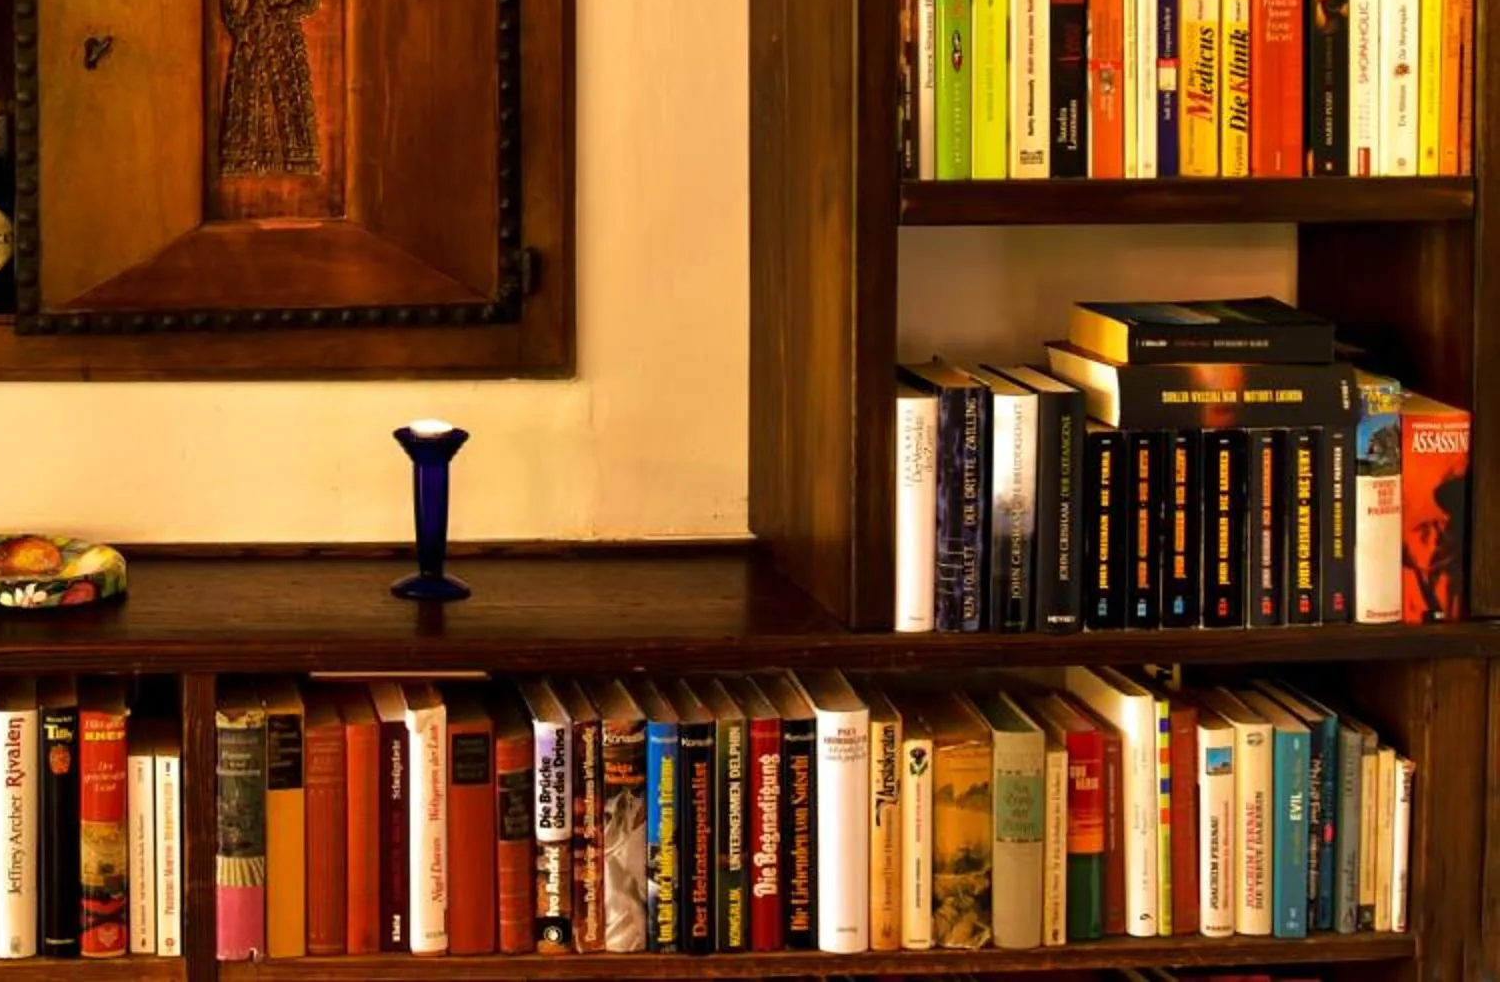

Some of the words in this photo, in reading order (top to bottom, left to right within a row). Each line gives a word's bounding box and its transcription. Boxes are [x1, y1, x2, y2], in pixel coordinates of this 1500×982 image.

[1228, 29, 1248, 94] Klinik
[1357, 1, 1370, 85] SHOPAHOLIC
[1186, 26, 1215, 124] Medicus
[1057, 107, 1068, 144] Sandra
[1228, 95, 1248, 133] Die
[963, 397, 976, 451] ZWILLING
[963, 456, 976, 499] DRITTE
[1297, 449, 1312, 478] JURY
[963, 504, 976, 525] DER
[1059, 501, 1070, 551] GRISHAM
[1297, 505, 1312, 559] GRISHAM
[1099, 514, 1111, 561] GRISHAM
[1218, 517, 1230, 559] GRISHAM
[963, 545, 976, 592] FOLLETT
[1010, 566, 1023, 599] JOHN
[1059, 553, 1070, 581] JOHN
[1099, 563, 1111, 589] JOHN
[1218, 561, 1230, 585] JOHN
[1297, 561, 1312, 589] JOHN
[963, 596, 976, 619] KEN
[43, 724, 74, 741] Tilly
[552, 728, 566, 768] Drina
[729, 726, 742, 779] DELPHIN
[4, 717, 25, 789] Rivalen
[539, 757, 552, 803] Brücke
[552, 770, 566, 794] die
[7, 795, 25, 845] Archer
[539, 805, 552, 829] Die
[552, 795, 566, 829] über
[729, 781, 742, 871] UNTERNEHMEN
[754, 753, 781, 867] Begnadigung
[789, 807, 810, 832] von
[1245, 802, 1255, 851] FERNAU
[1289, 792, 1303, 822] EVIL
[691, 760, 710, 903] Heiratsspezialist
[1210, 815, 1219, 859] FERNAU
[7, 847, 25, 897] Jeffrey
[754, 867, 781, 899] Die
[789, 833, 810, 904] Liebenden
[1210, 860, 1219, 911] JOACHIM
[1245, 854, 1255, 910] JOACHIM
[545, 894, 559, 917] Ivo
[658, 879, 675, 902] der
[658, 903, 675, 921] Tal
[691, 906, 710, 938] Der
[789, 907, 810, 931] Die
[658, 925, 675, 943] Im
